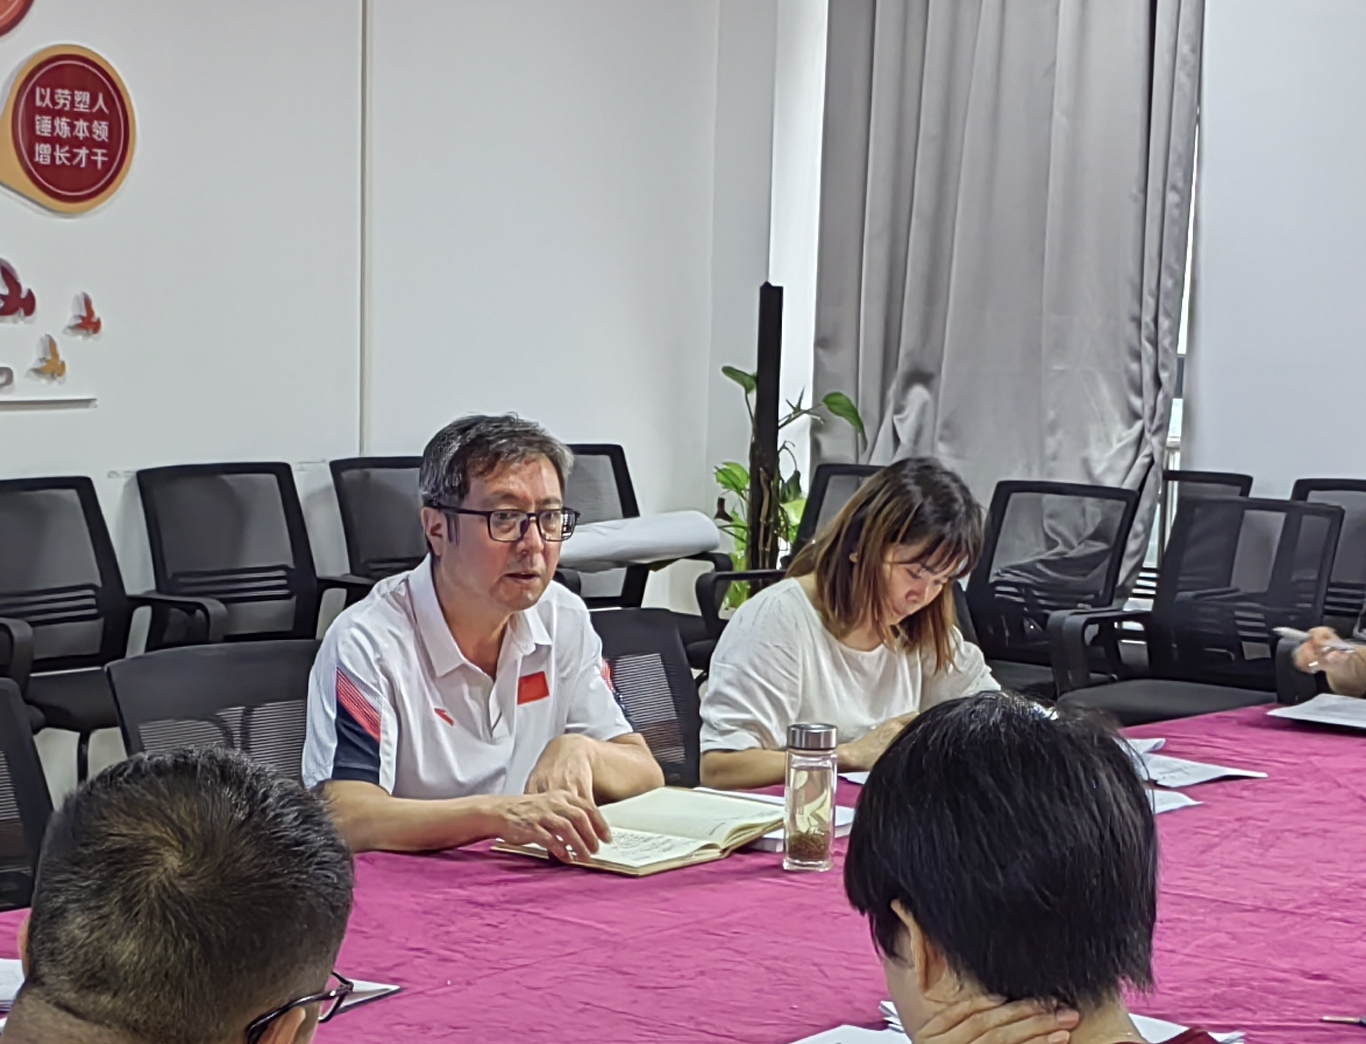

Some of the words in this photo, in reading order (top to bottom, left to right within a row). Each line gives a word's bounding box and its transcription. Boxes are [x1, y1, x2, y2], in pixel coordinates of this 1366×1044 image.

[35, 86, 110, 115] 以劳塑人
[34, 114, 110, 143] 锤炼本领
[34, 141, 110, 170] 增长才干
